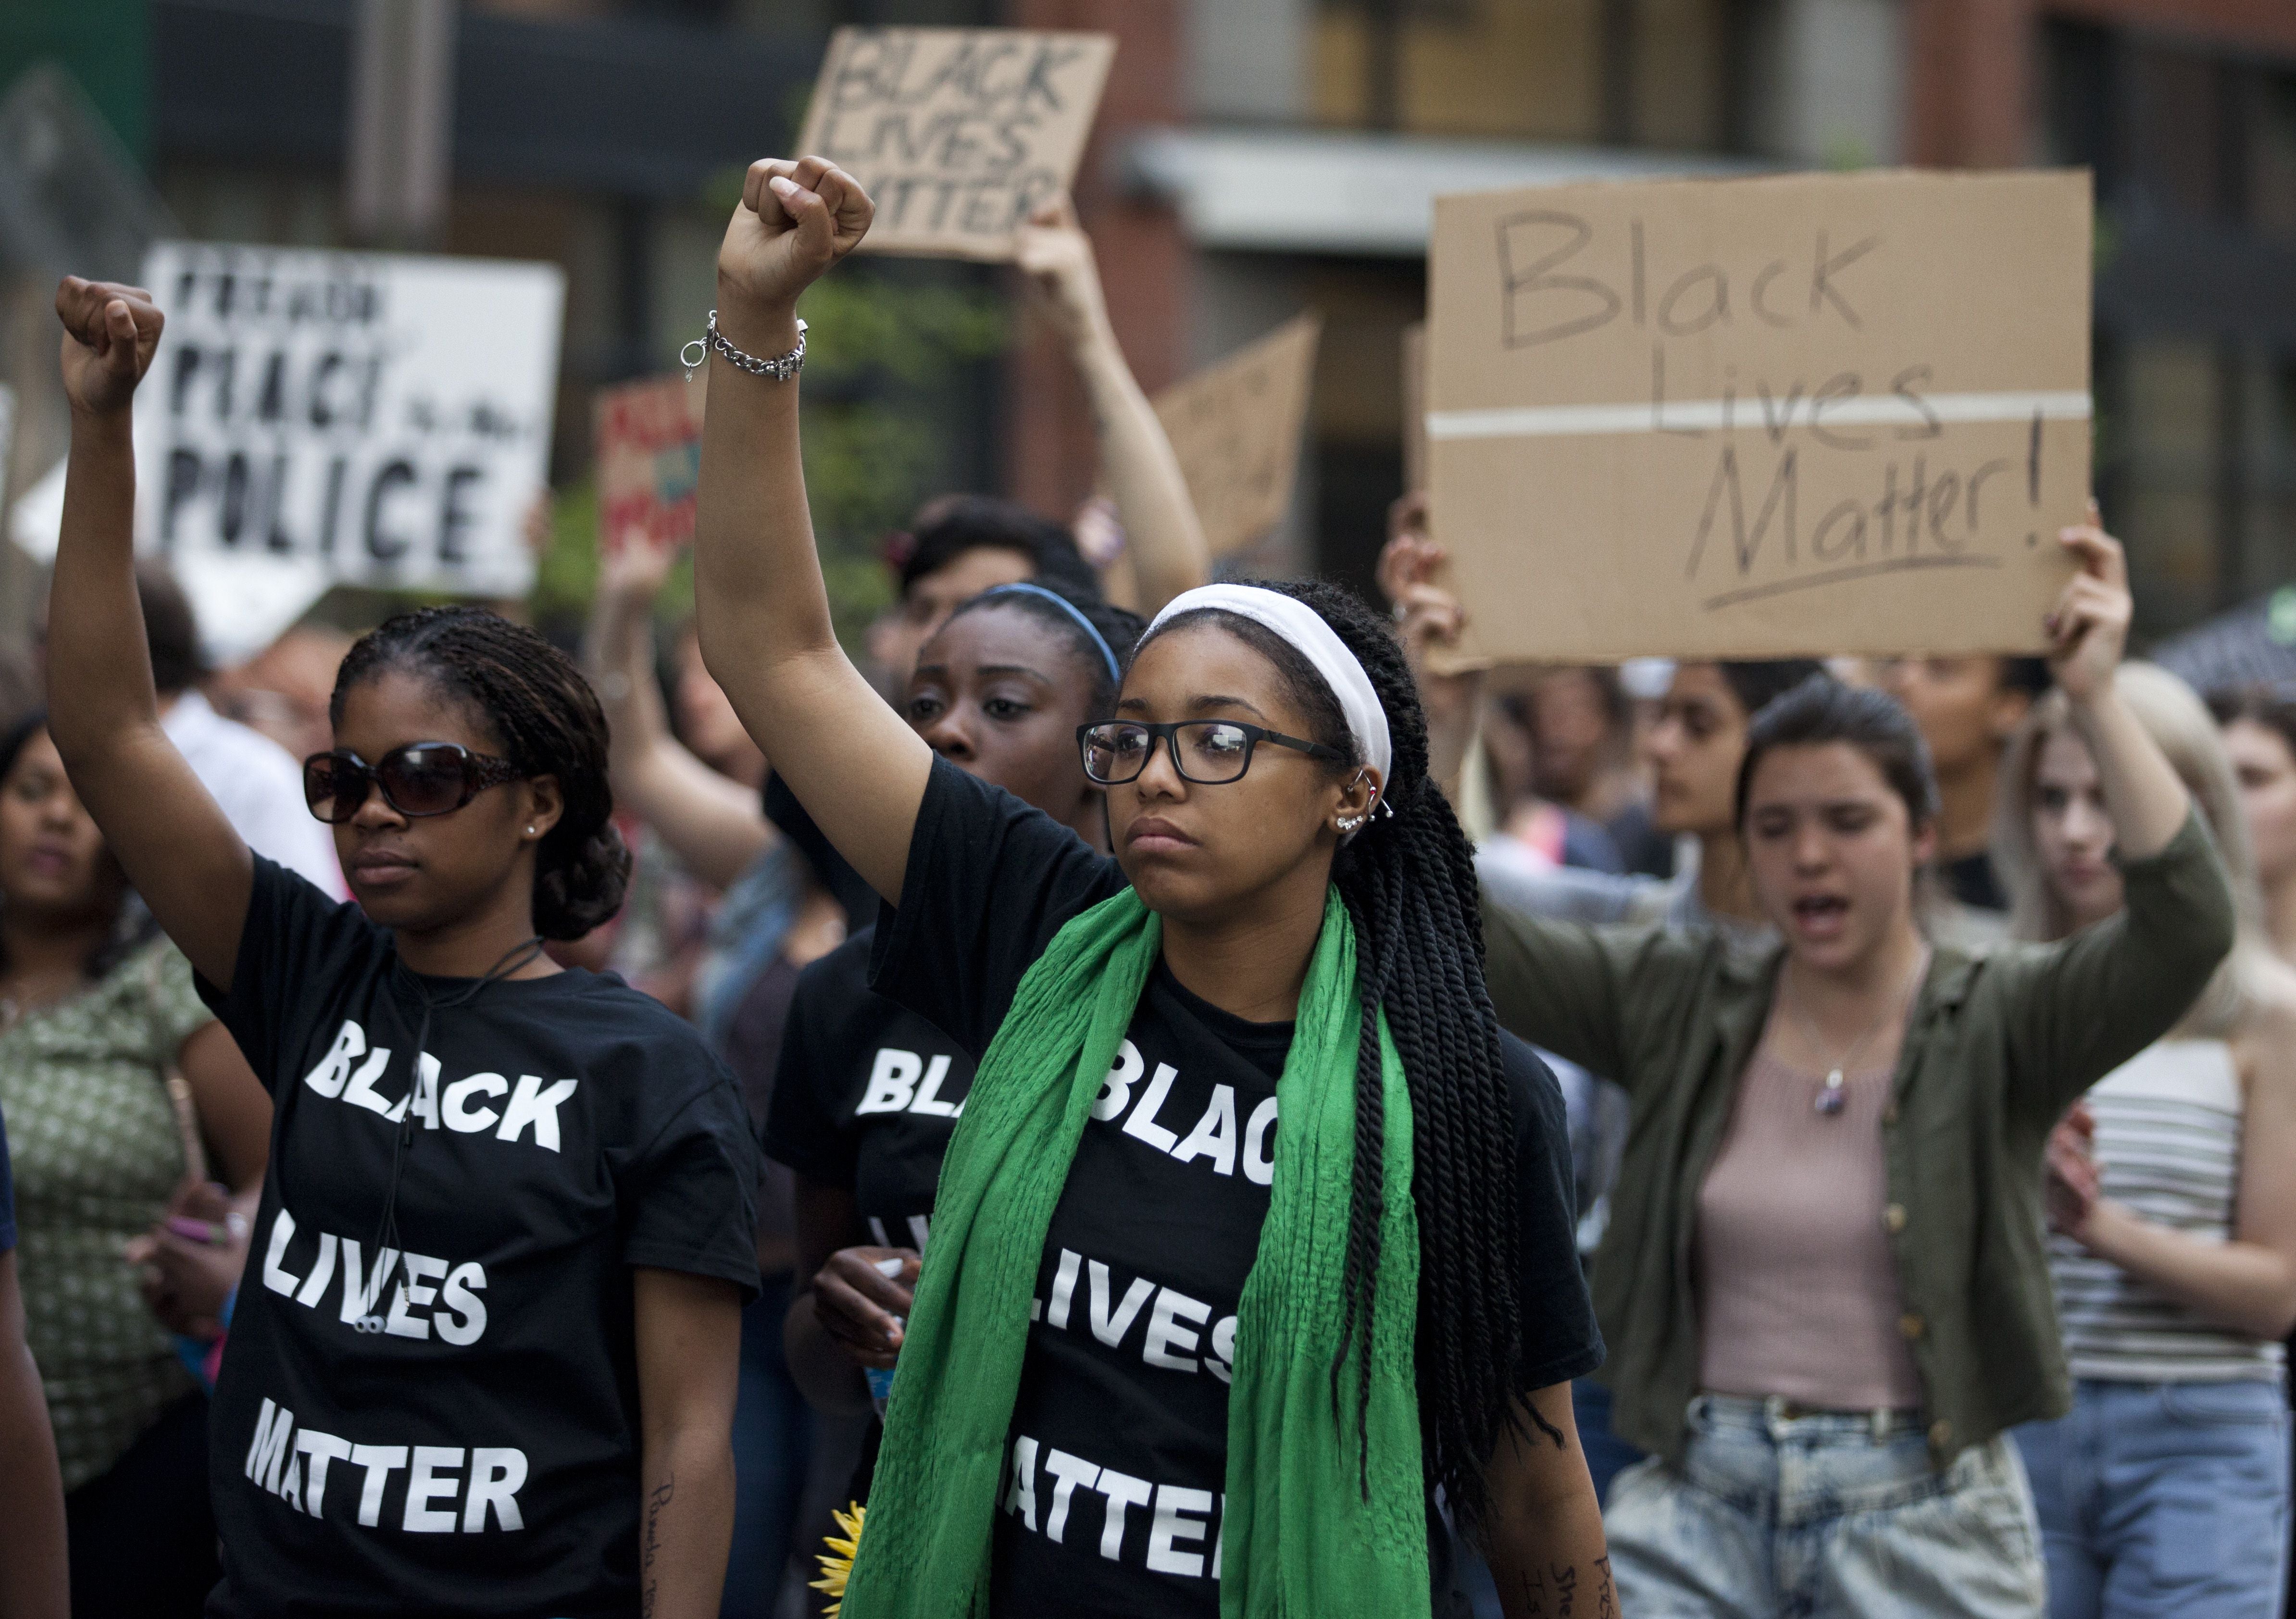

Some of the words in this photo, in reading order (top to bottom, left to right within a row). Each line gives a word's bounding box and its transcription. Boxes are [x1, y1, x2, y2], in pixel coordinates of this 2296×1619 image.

[834, 30, 1085, 114] BLACK
[819, 112, 1042, 170] LIVES
[1495, 209, 1887, 350] Black
[1651, 342, 1943, 451] Lives
[160, 445, 485, 564] POLICE
[304, 1019, 579, 1153] BLACK
[854, 1047, 968, 1119] BL
[262, 1208, 487, 1346] LIVES
[1030, 1247, 1238, 1384] IVES
[244, 1397, 528, 1533] MATTER
[996, 1434, 1226, 1580] ATTE
[1549, 1562, 1577, 1617] She
